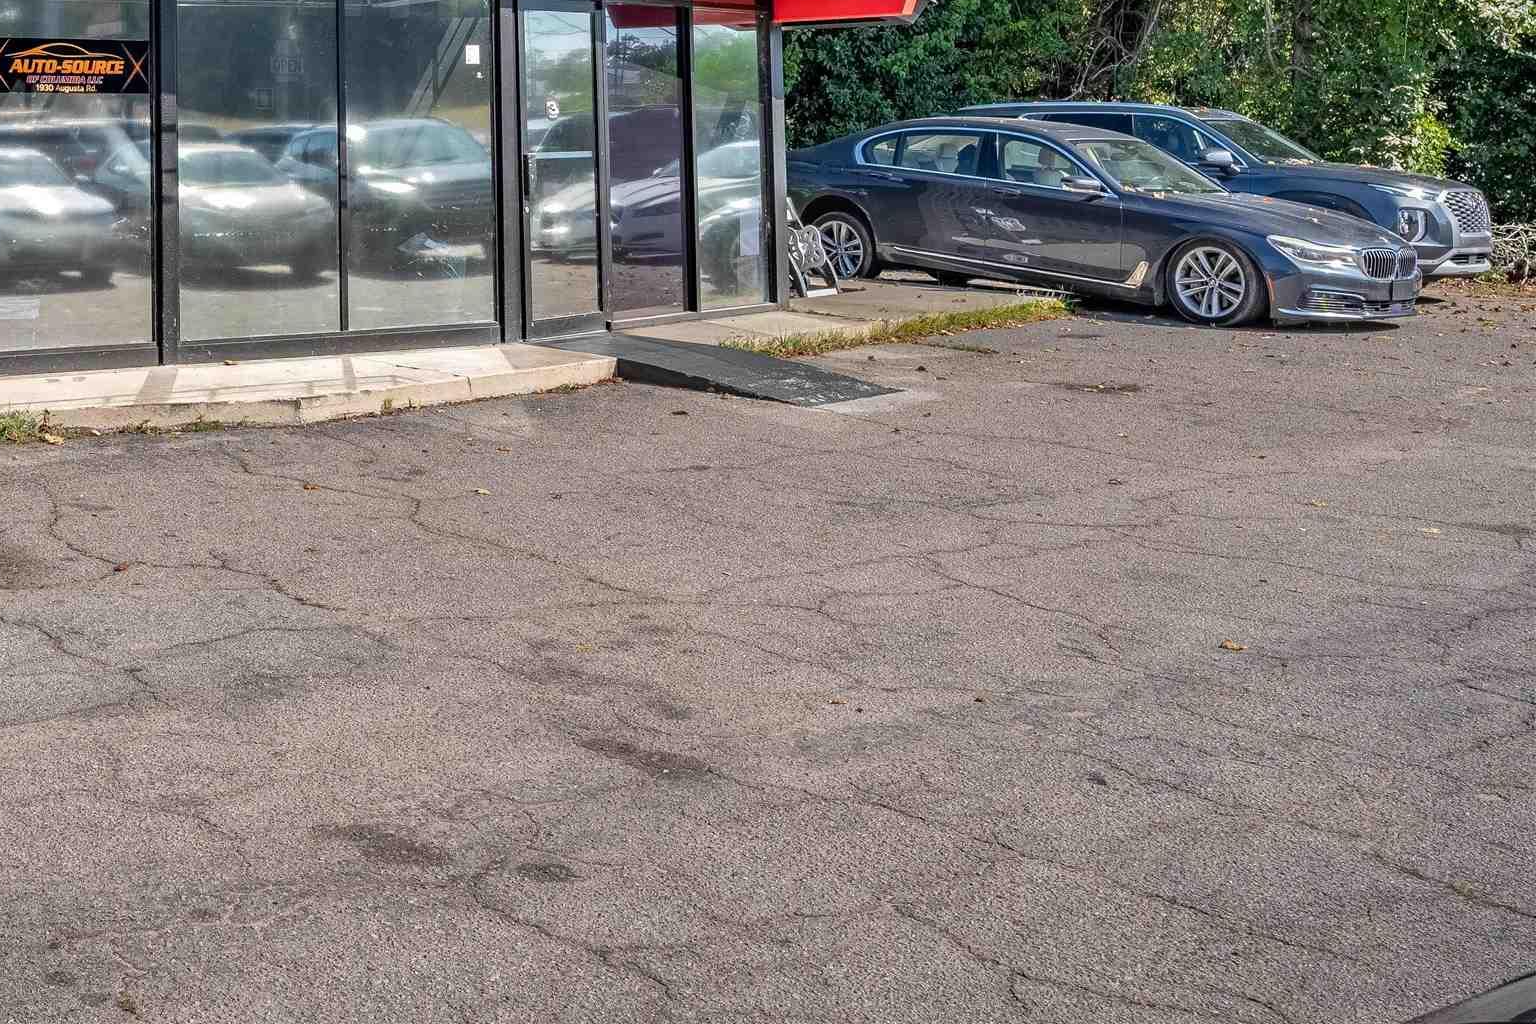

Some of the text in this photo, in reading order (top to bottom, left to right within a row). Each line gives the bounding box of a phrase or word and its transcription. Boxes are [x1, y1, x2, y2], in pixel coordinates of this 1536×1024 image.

[8, 58, 125, 75] AUTO-SOURCE
[36, 84, 54, 92] 1930
[55, 84, 85, 93] Augusta
